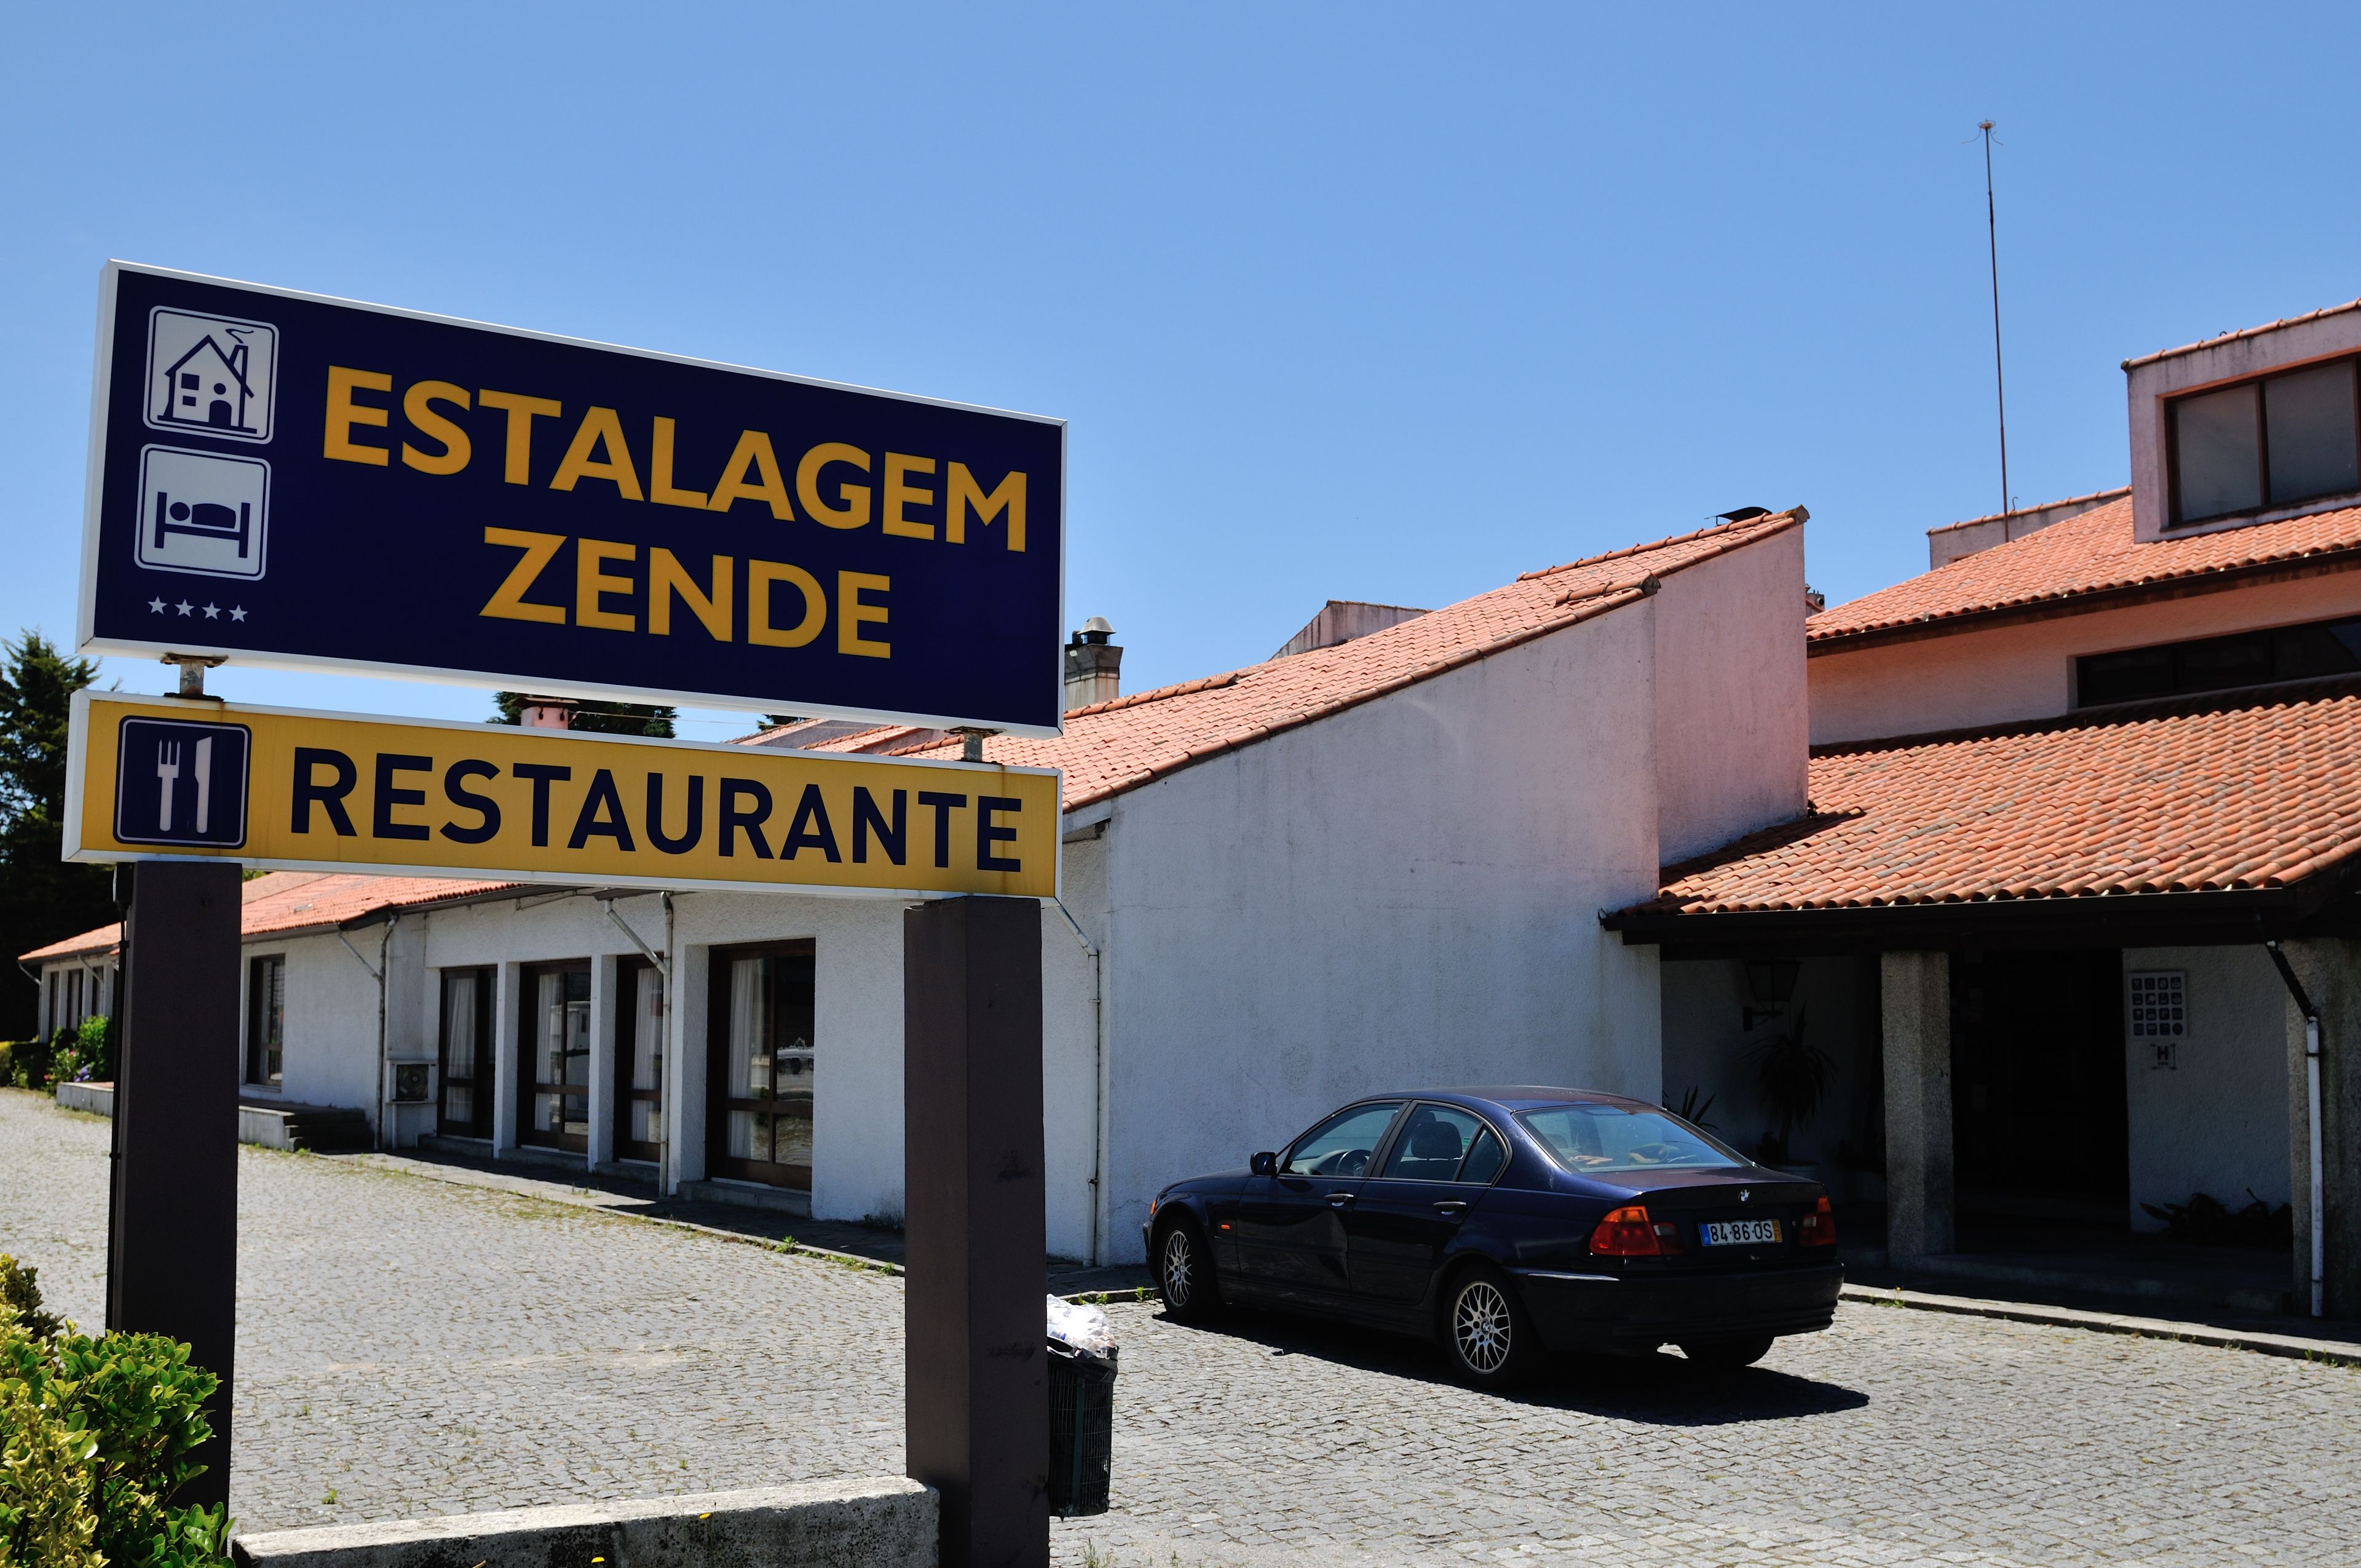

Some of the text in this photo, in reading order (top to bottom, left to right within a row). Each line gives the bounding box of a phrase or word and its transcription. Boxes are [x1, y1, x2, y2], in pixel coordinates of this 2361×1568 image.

[324, 366, 1027, 552] ESTALAGEM
[480, 526, 891, 659] ZENDE
[291, 746, 1022, 873] RESTAURANTE
[2157, 1045, 2169, 1061] H
